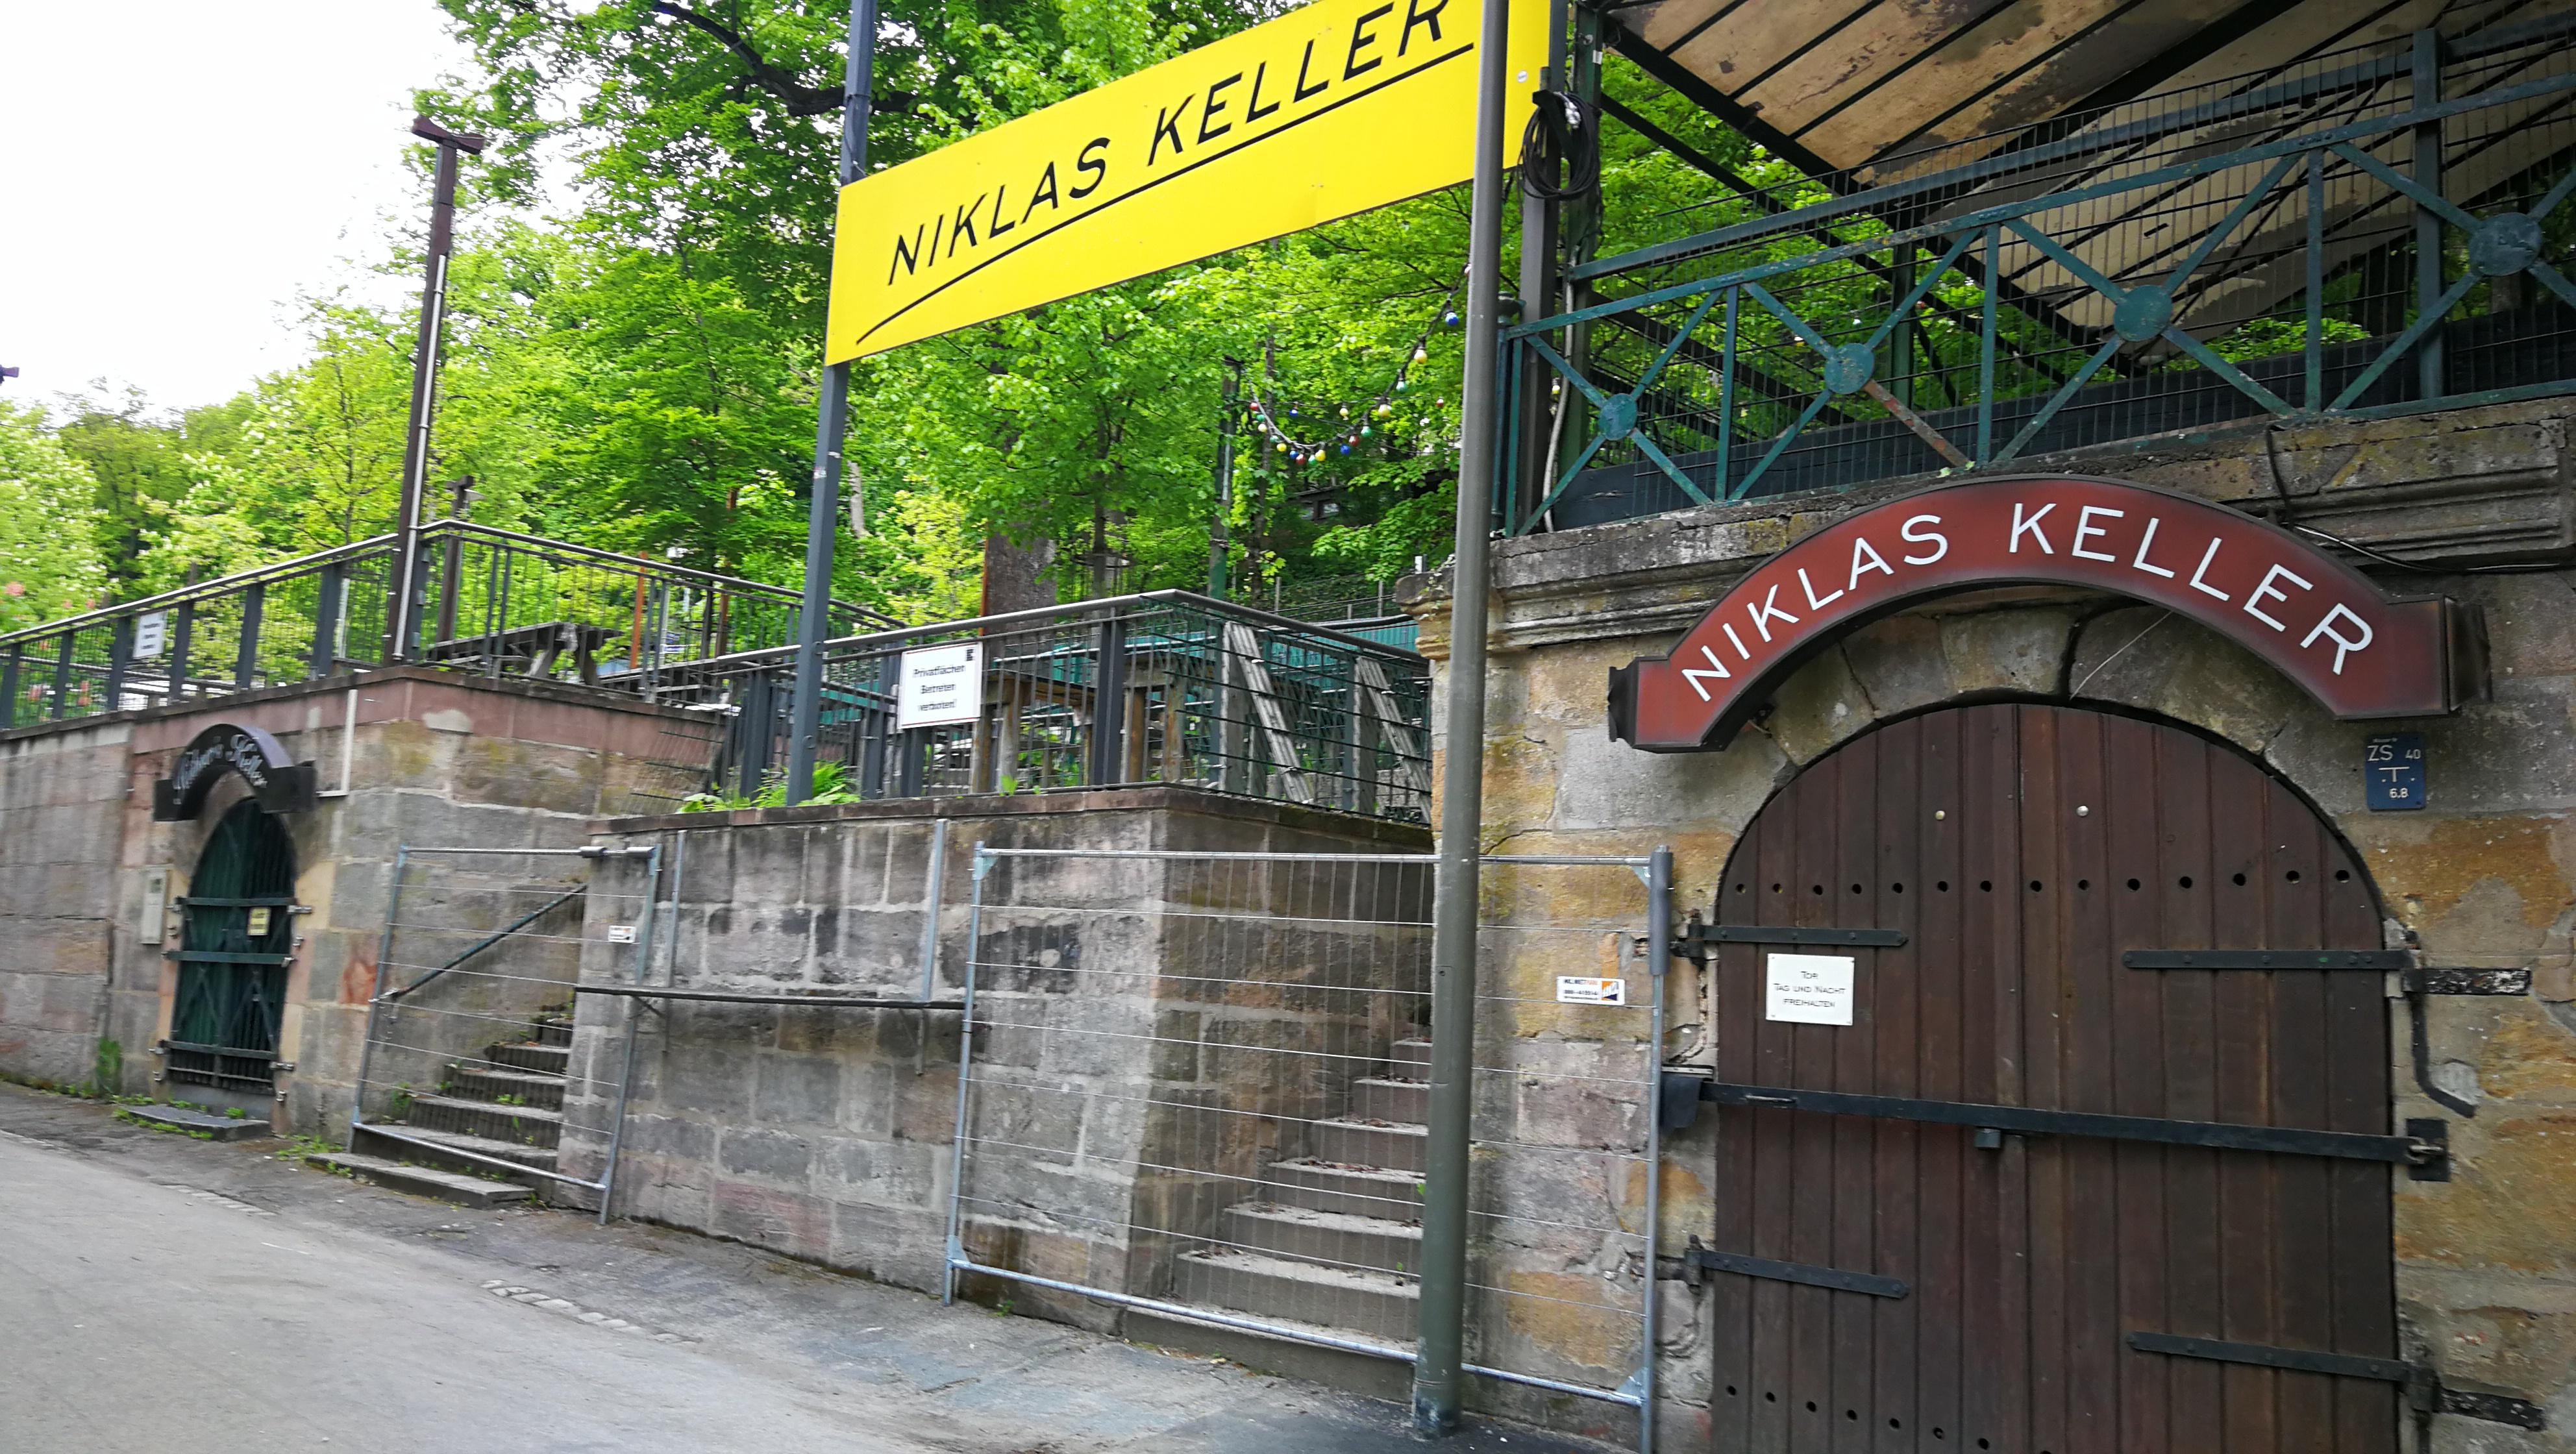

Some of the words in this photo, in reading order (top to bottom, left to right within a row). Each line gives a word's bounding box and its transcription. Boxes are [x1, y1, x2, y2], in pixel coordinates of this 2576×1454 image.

[887, 137, 1111, 286] NIKLAS
[1148, 0, 1448, 166] KELLER
[1681, 514, 1948, 702] NIKLAS
[2009, 503, 2373, 675] KELLER
[920, 684, 956, 694] Betreten
[2367, 745, 2394, 761] ZS
[2405, 749, 2421, 759] 40
